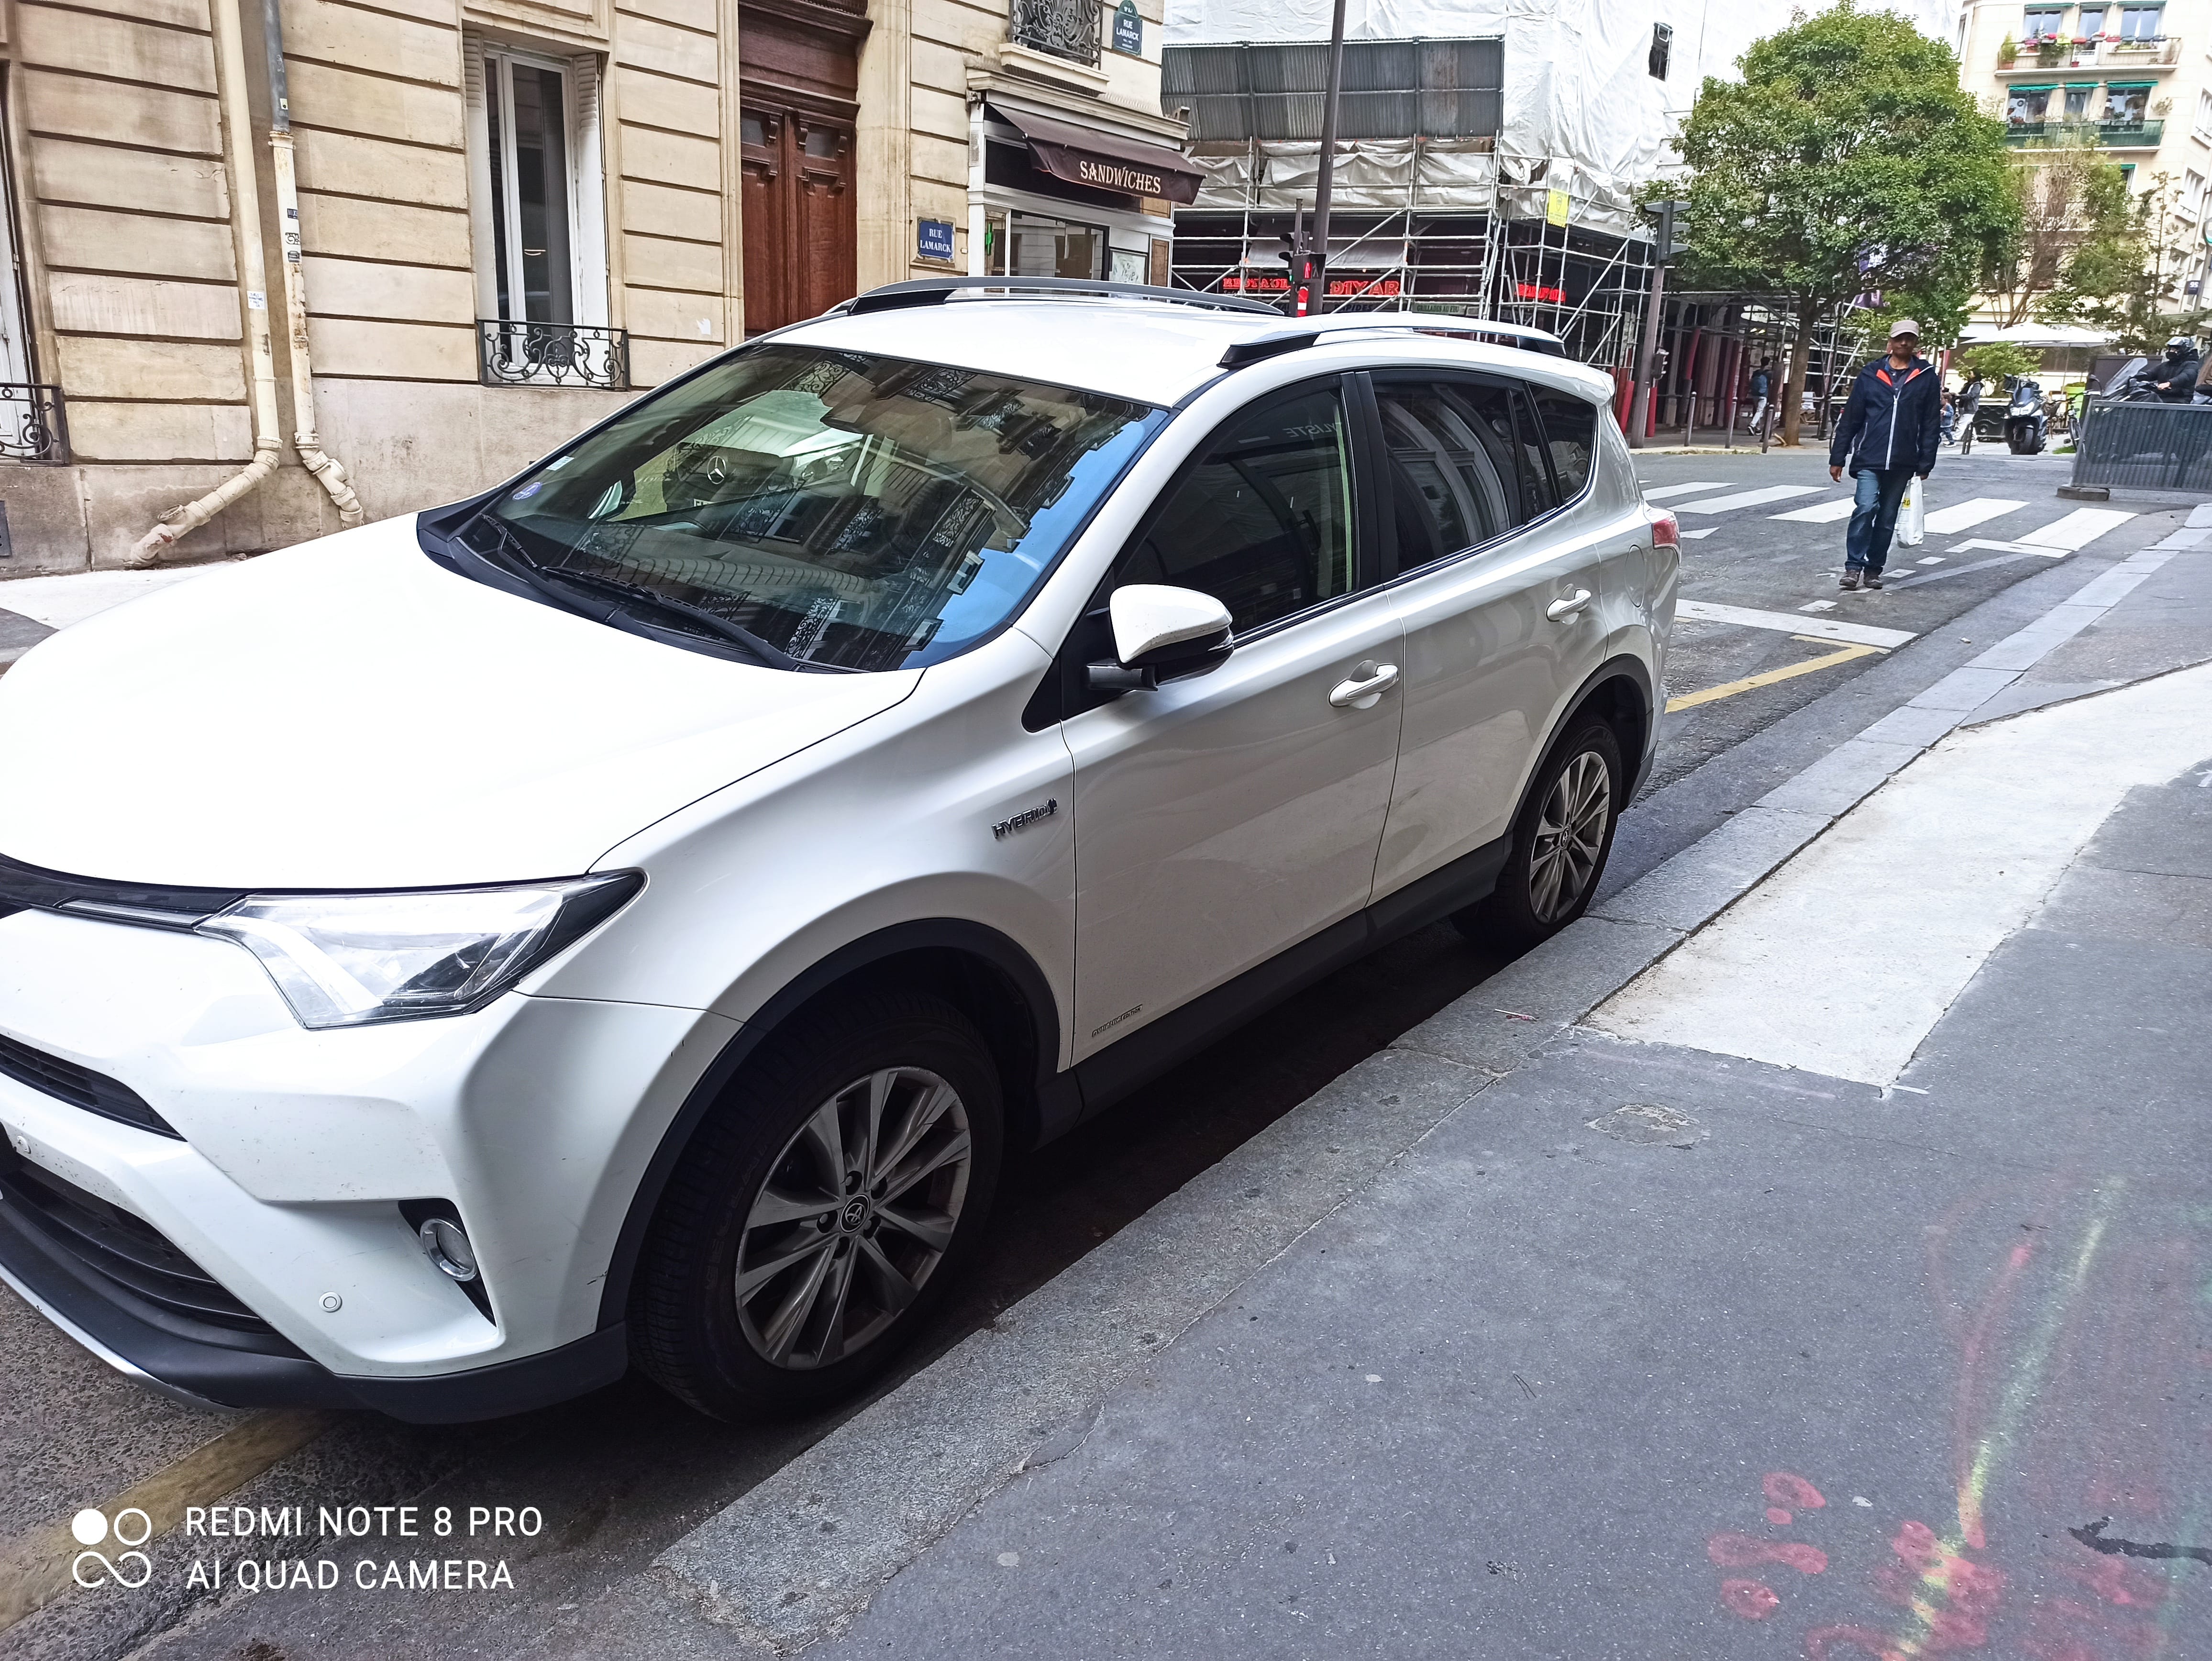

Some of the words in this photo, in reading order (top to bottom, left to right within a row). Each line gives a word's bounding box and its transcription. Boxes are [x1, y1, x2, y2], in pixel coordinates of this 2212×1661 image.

[1123, 19, 1133, 29] RUE
[1116, 27, 1139, 41] LAMARCK
[1080, 161, 1161, 194] SANDWICHES
[929, 228, 942, 238] RUE
[920, 240, 951, 253] LAMARCK
[1223, 278, 1291, 288] RESTAUR
[1330, 281, 1399, 296] DIYAR
[991, 805, 1048, 839] HYBRID
